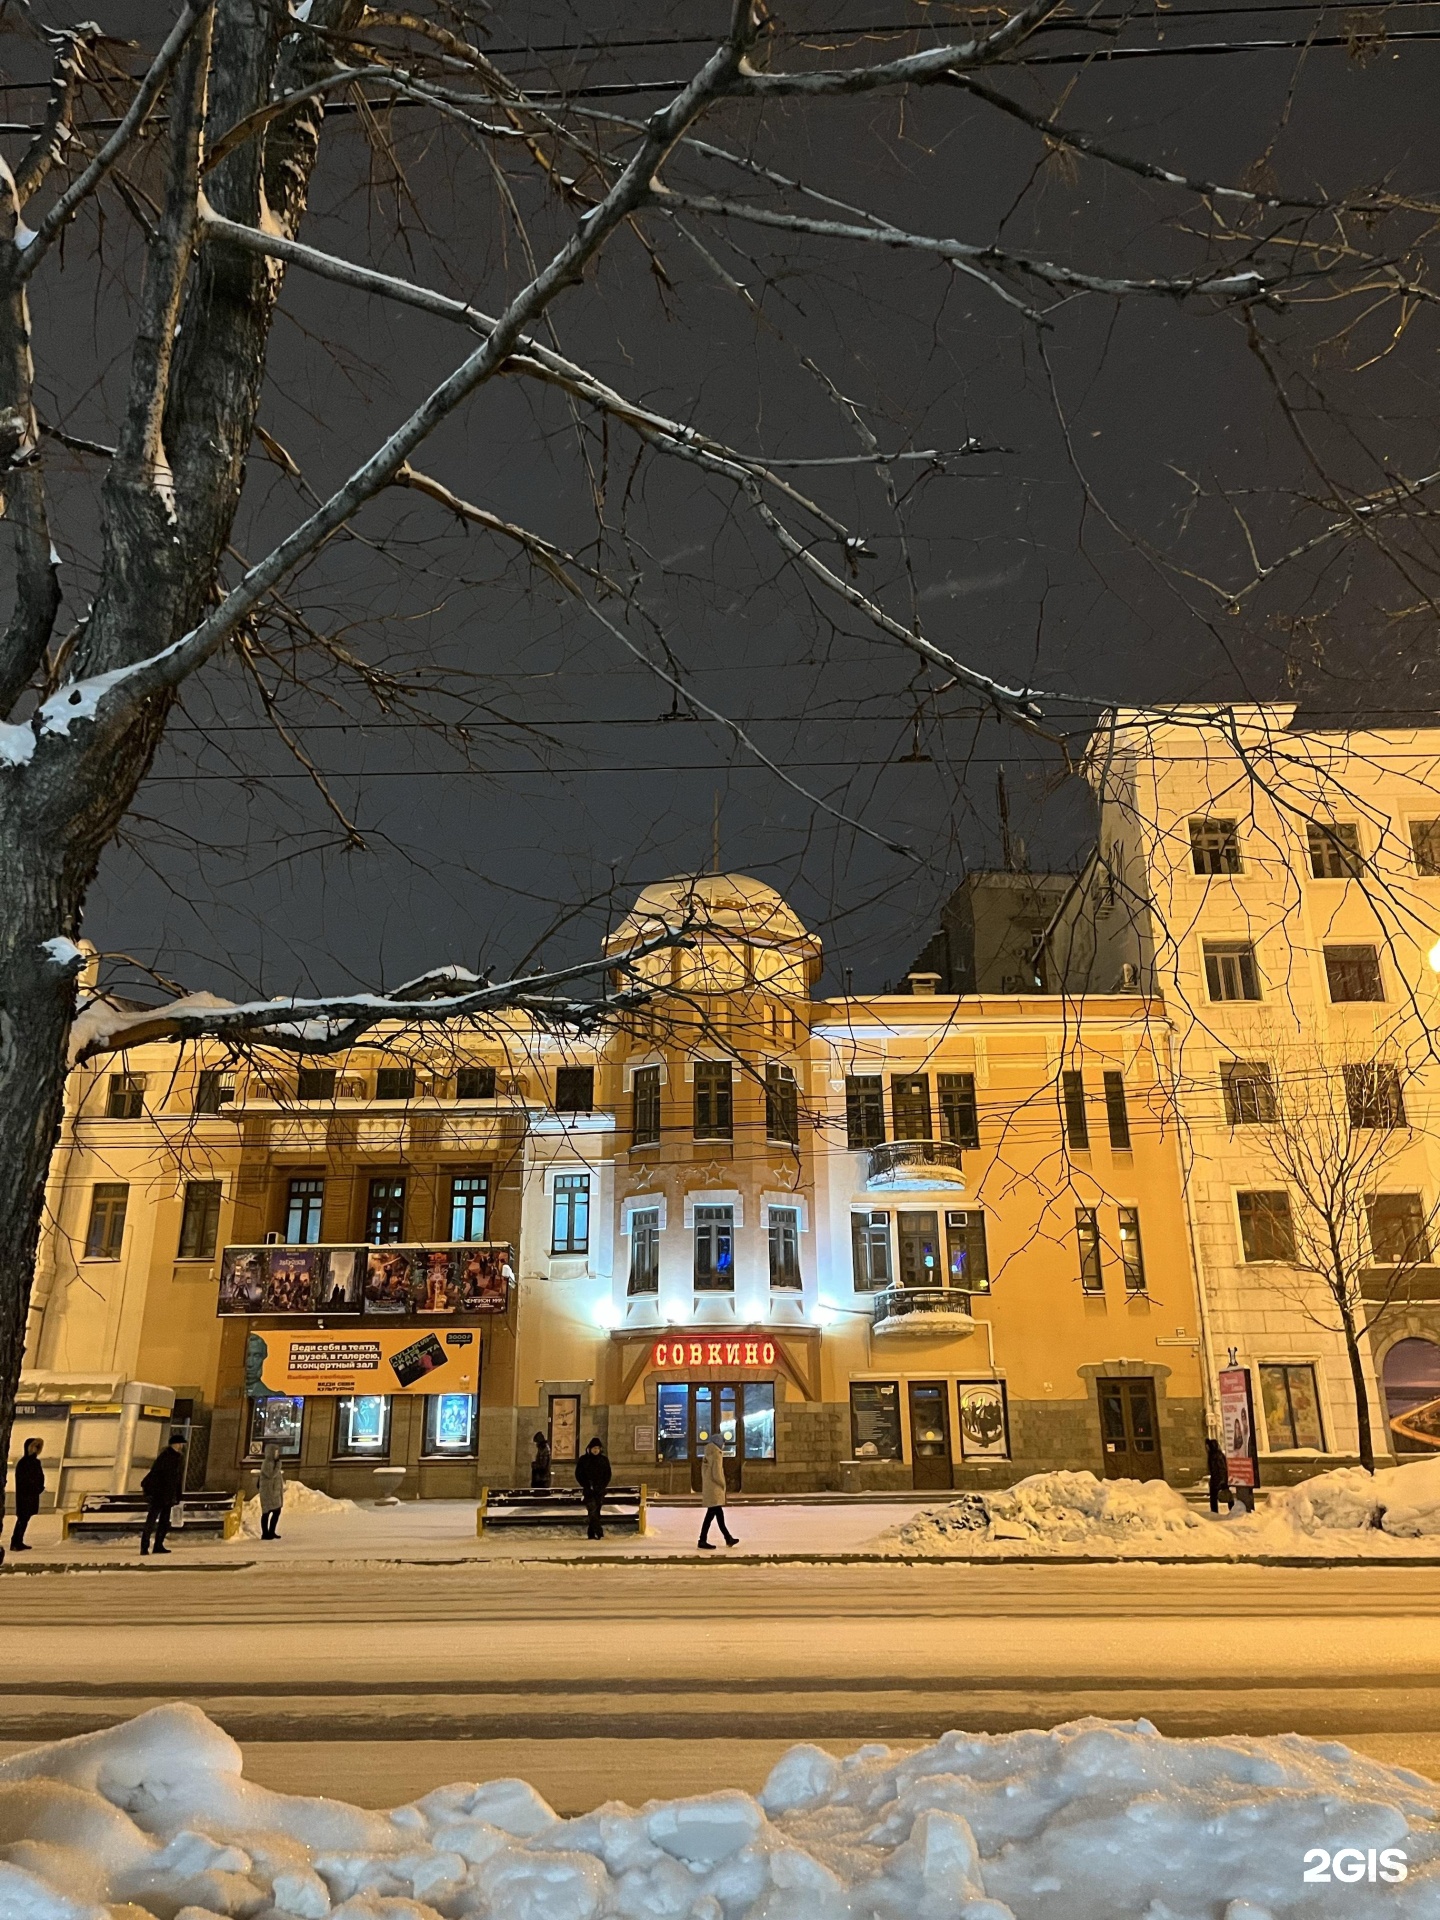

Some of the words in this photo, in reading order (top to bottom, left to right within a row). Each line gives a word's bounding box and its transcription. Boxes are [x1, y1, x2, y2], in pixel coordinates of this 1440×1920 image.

[291, 1344, 316, 1352] Веди
[317, 1343, 341, 1351] себя
[348, 1344, 378, 1352] театр,
[297, 1352, 329, 1361] музей,
[336, 1353, 380, 1361] галерею,
[656, 1343, 775, 1365] СОВКИНО
[296, 1361, 355, 1370] концертный
